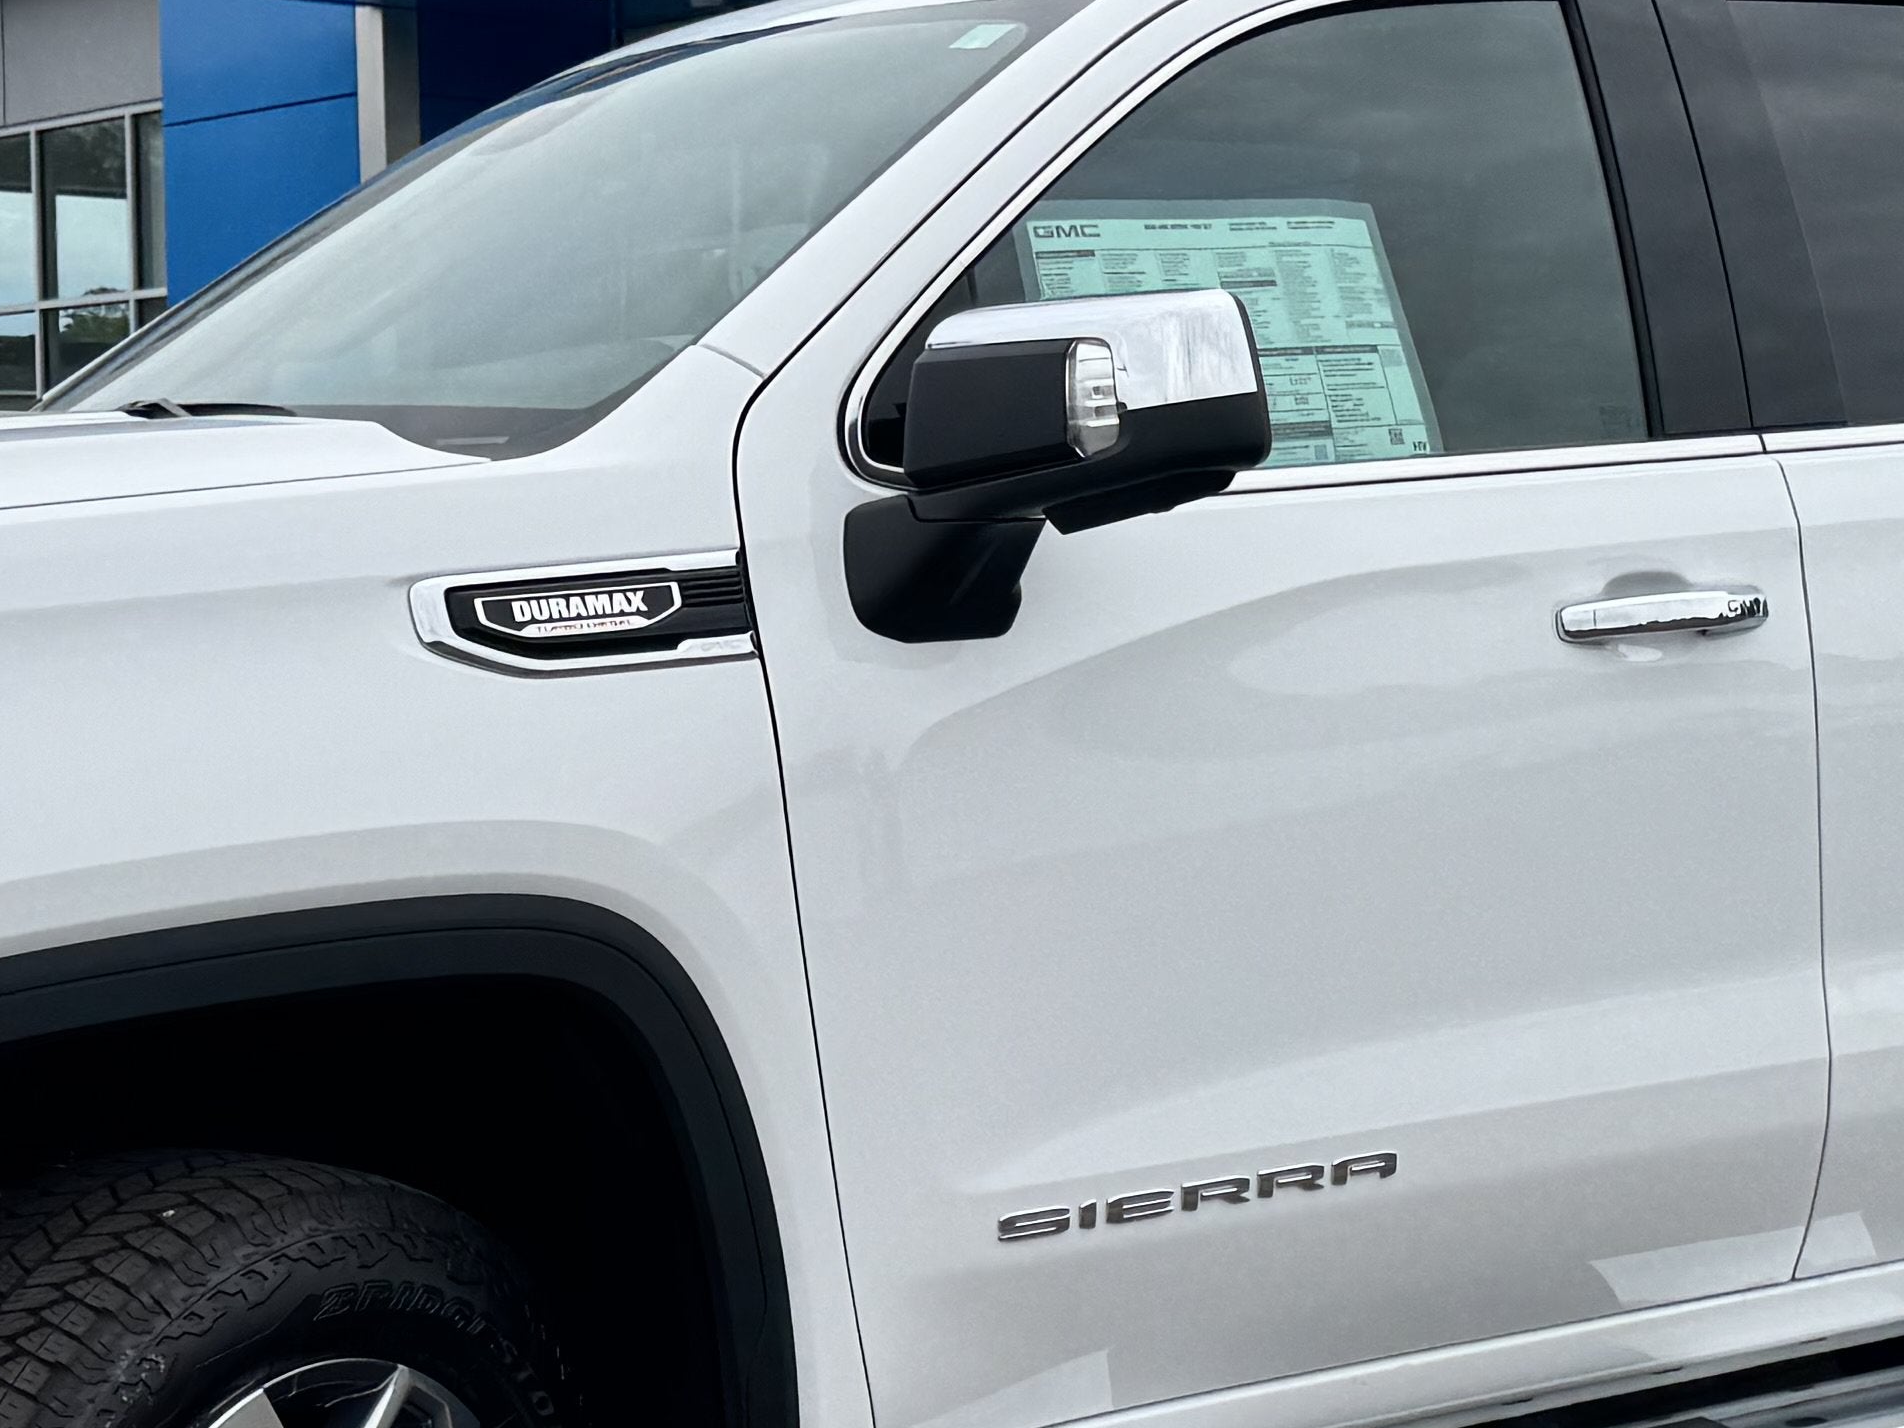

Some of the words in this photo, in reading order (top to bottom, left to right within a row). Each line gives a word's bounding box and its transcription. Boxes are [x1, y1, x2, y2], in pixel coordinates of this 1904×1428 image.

[1033, 224, 1101, 239] GMC
[511, 590, 648, 623] DURAMAX
[997, 1149, 1398, 1242] SIERRA
